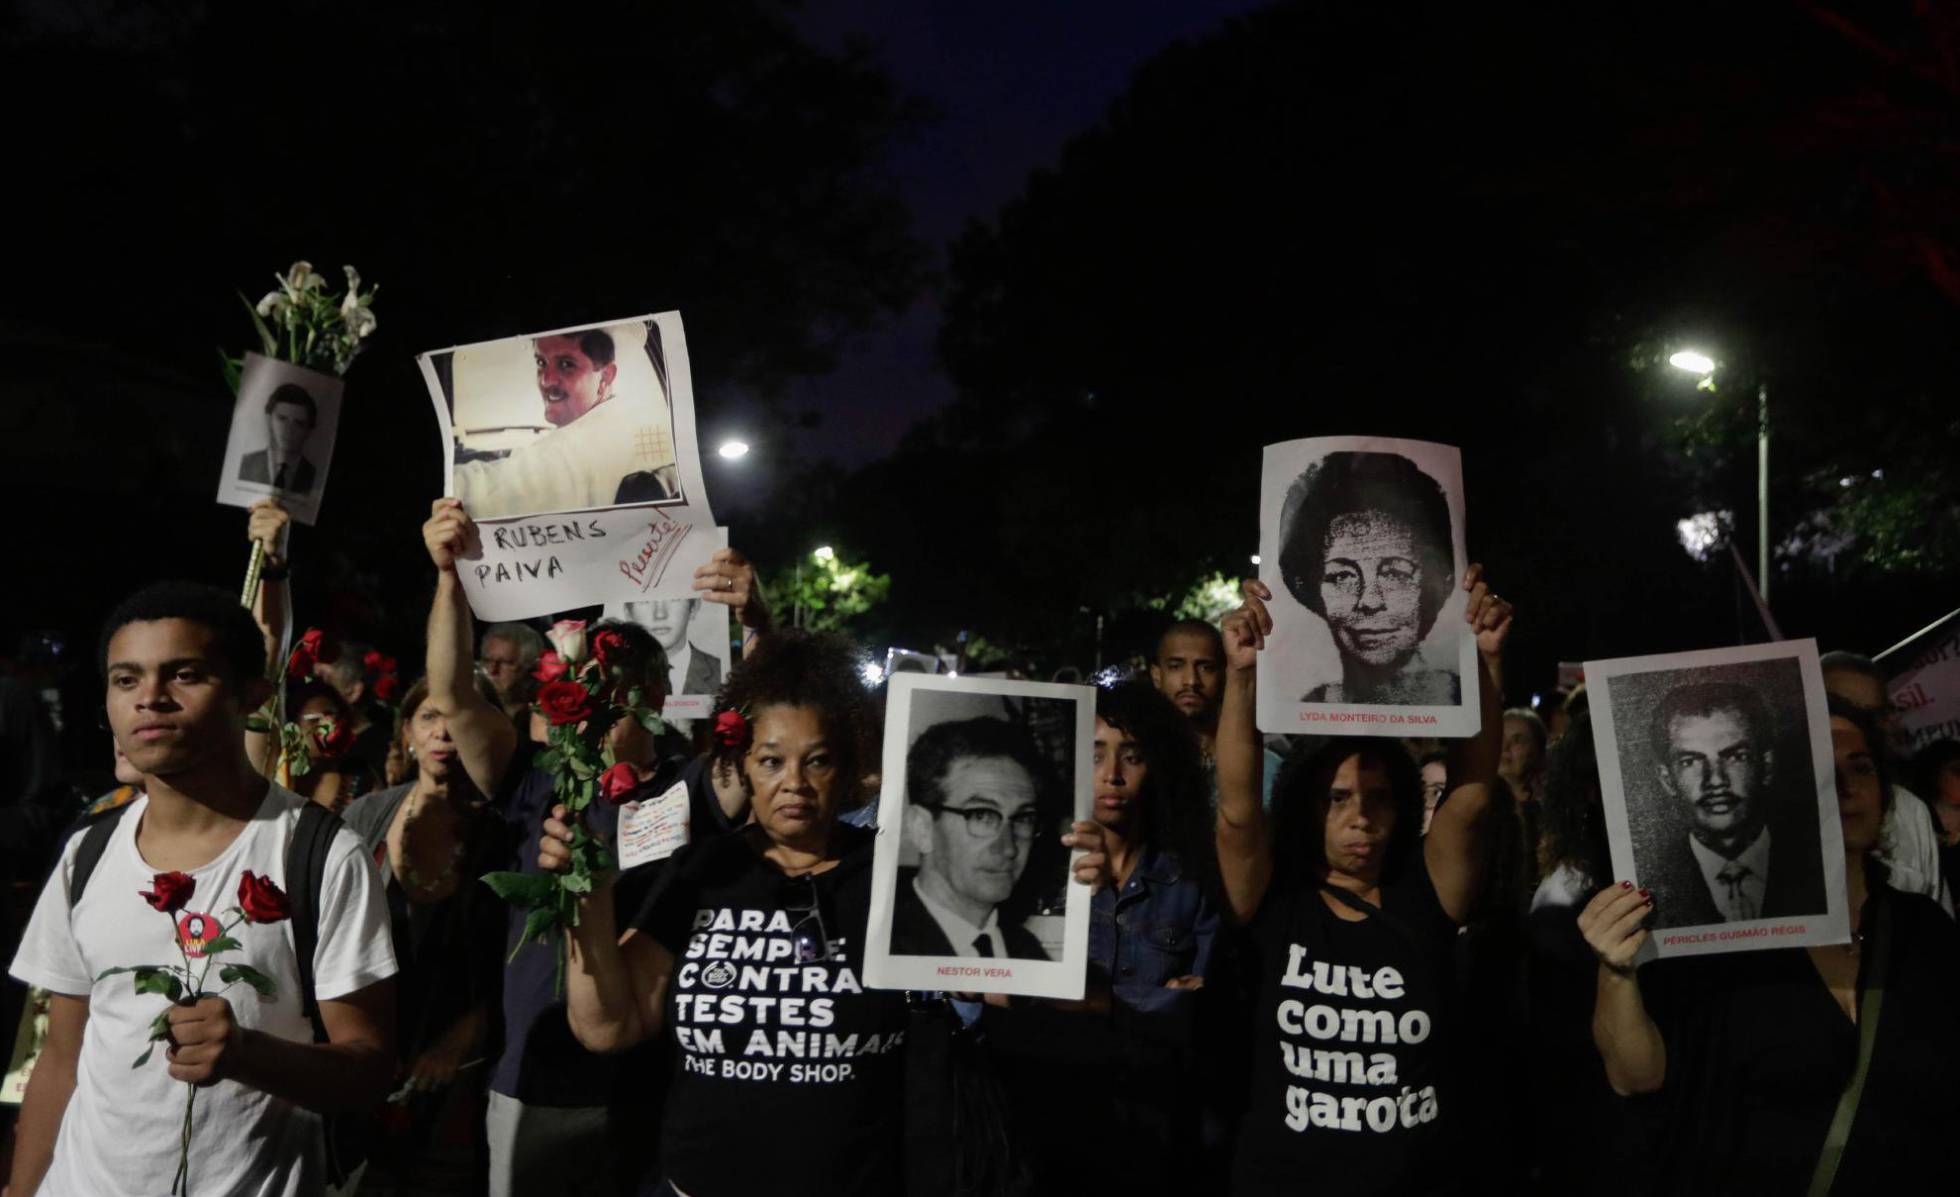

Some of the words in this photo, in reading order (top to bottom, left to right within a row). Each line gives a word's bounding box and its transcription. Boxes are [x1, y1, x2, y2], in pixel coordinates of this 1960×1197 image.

[493, 519, 607, 549] RUBENS
[474, 556, 564, 588] PAIVA
[1299, 711, 1327, 721] LYDA
[1329, 712, 1386, 723] MONTEIRO
[1390, 715, 1405, 723] DA
[1407, 715, 1437, 725] SILVA
[692, 908, 792, 932] PARA
[937, 966, 980, 976] NESTOR
[984, 967, 1012, 977] VERA
[1281, 943, 1405, 999] Lute
[675, 994, 835, 1027] TESTES
[1277, 999, 1431, 1045] como
[675, 1026, 726, 1054] EM
[684, 1054, 715, 1075] THE
[722, 1059, 783, 1081] BODY
[1279, 1040, 1399, 1086] uma
[1284, 1084, 1438, 1133] garota
